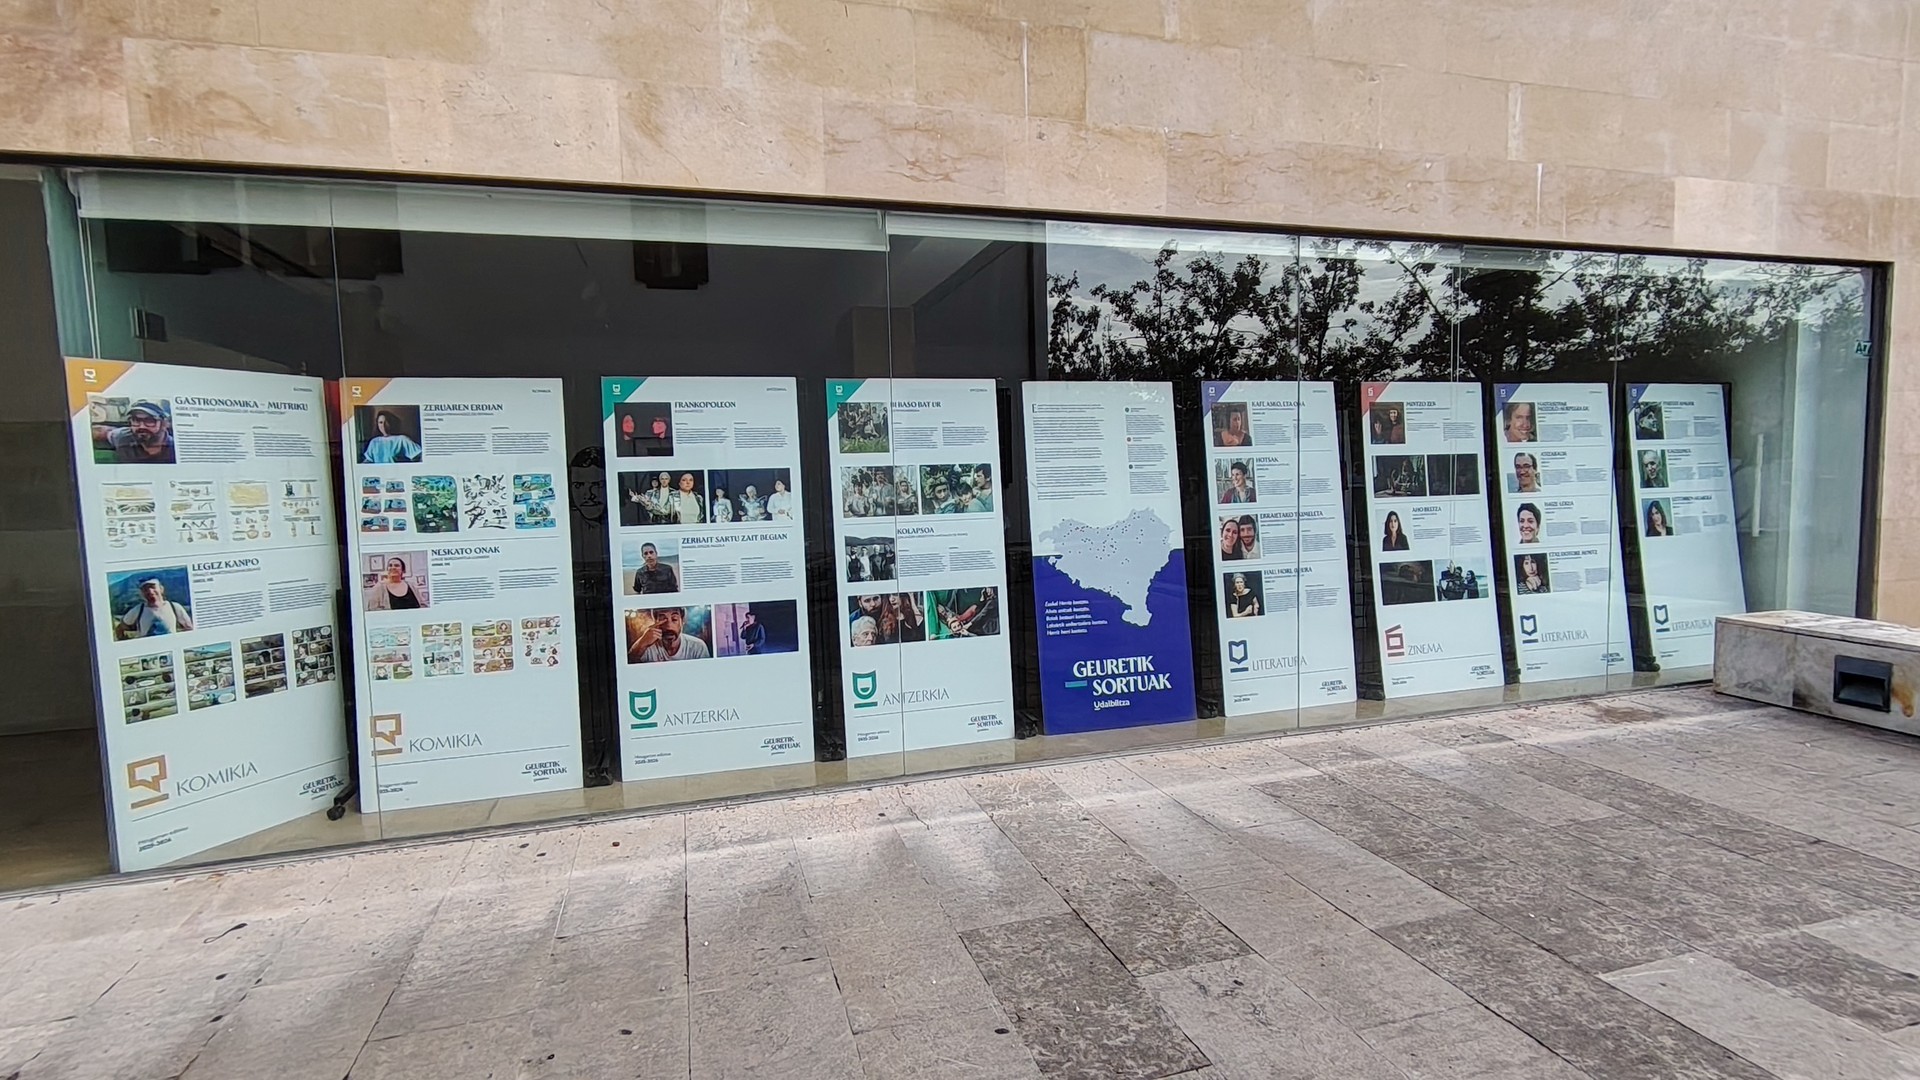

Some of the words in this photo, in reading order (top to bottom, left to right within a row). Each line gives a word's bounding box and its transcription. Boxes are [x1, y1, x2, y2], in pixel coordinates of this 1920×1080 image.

[174, 396, 259, 409] GASTRONOMIKA
[267, 401, 309, 411] MUTRIKU
[423, 403, 470, 412] ZERUAREN
[470, 403, 503, 411] ERDIAN
[897, 526, 935, 535] KOLAPSOA
[715, 535, 740, 543] SARTU
[741, 534, 759, 542] ZAIT
[431, 547, 473, 557] NESKATO
[473, 546, 501, 555] ONAK
[191, 560, 223, 572] LEGEZ
[224, 557, 260, 569] KANPO
[1541, 629, 1590, 643] LITERATURA
[1408, 643, 1444, 656] ZINEMA
[1072, 655, 1155, 678] GEURETIK
[1252, 655, 1308, 671] LITERATURA
[1092, 673, 1172, 697] SORTUAK
[882, 687, 951, 706] ANTZERKIA
[1093, 698, 1130, 711] Udalbiltza
[663, 708, 740, 728] ANTZERKIA
[409, 733, 483, 753] KOMIKIA
[524, 760, 561, 771] GEURETIK
[532, 766, 568, 777] SORTUAK
[176, 760, 259, 797] KOMIKIA
